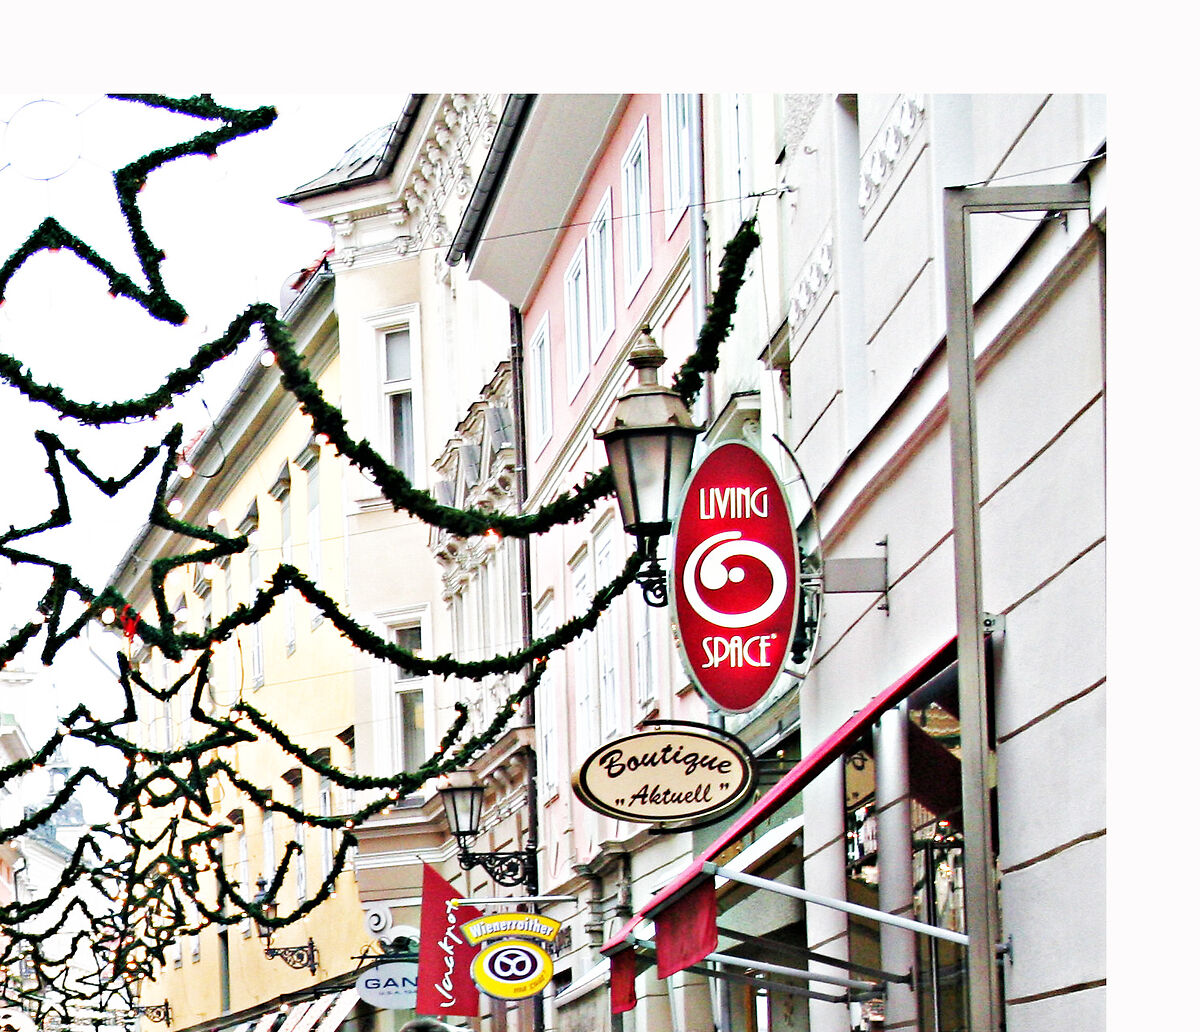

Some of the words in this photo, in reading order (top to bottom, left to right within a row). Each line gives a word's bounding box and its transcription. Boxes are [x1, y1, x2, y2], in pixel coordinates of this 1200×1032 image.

[699, 486, 769, 520] LIVING
[600, 743, 732, 779] Boutique
[469, 917, 554, 939] Wienerroither
[364, 976, 419, 989] GAN
